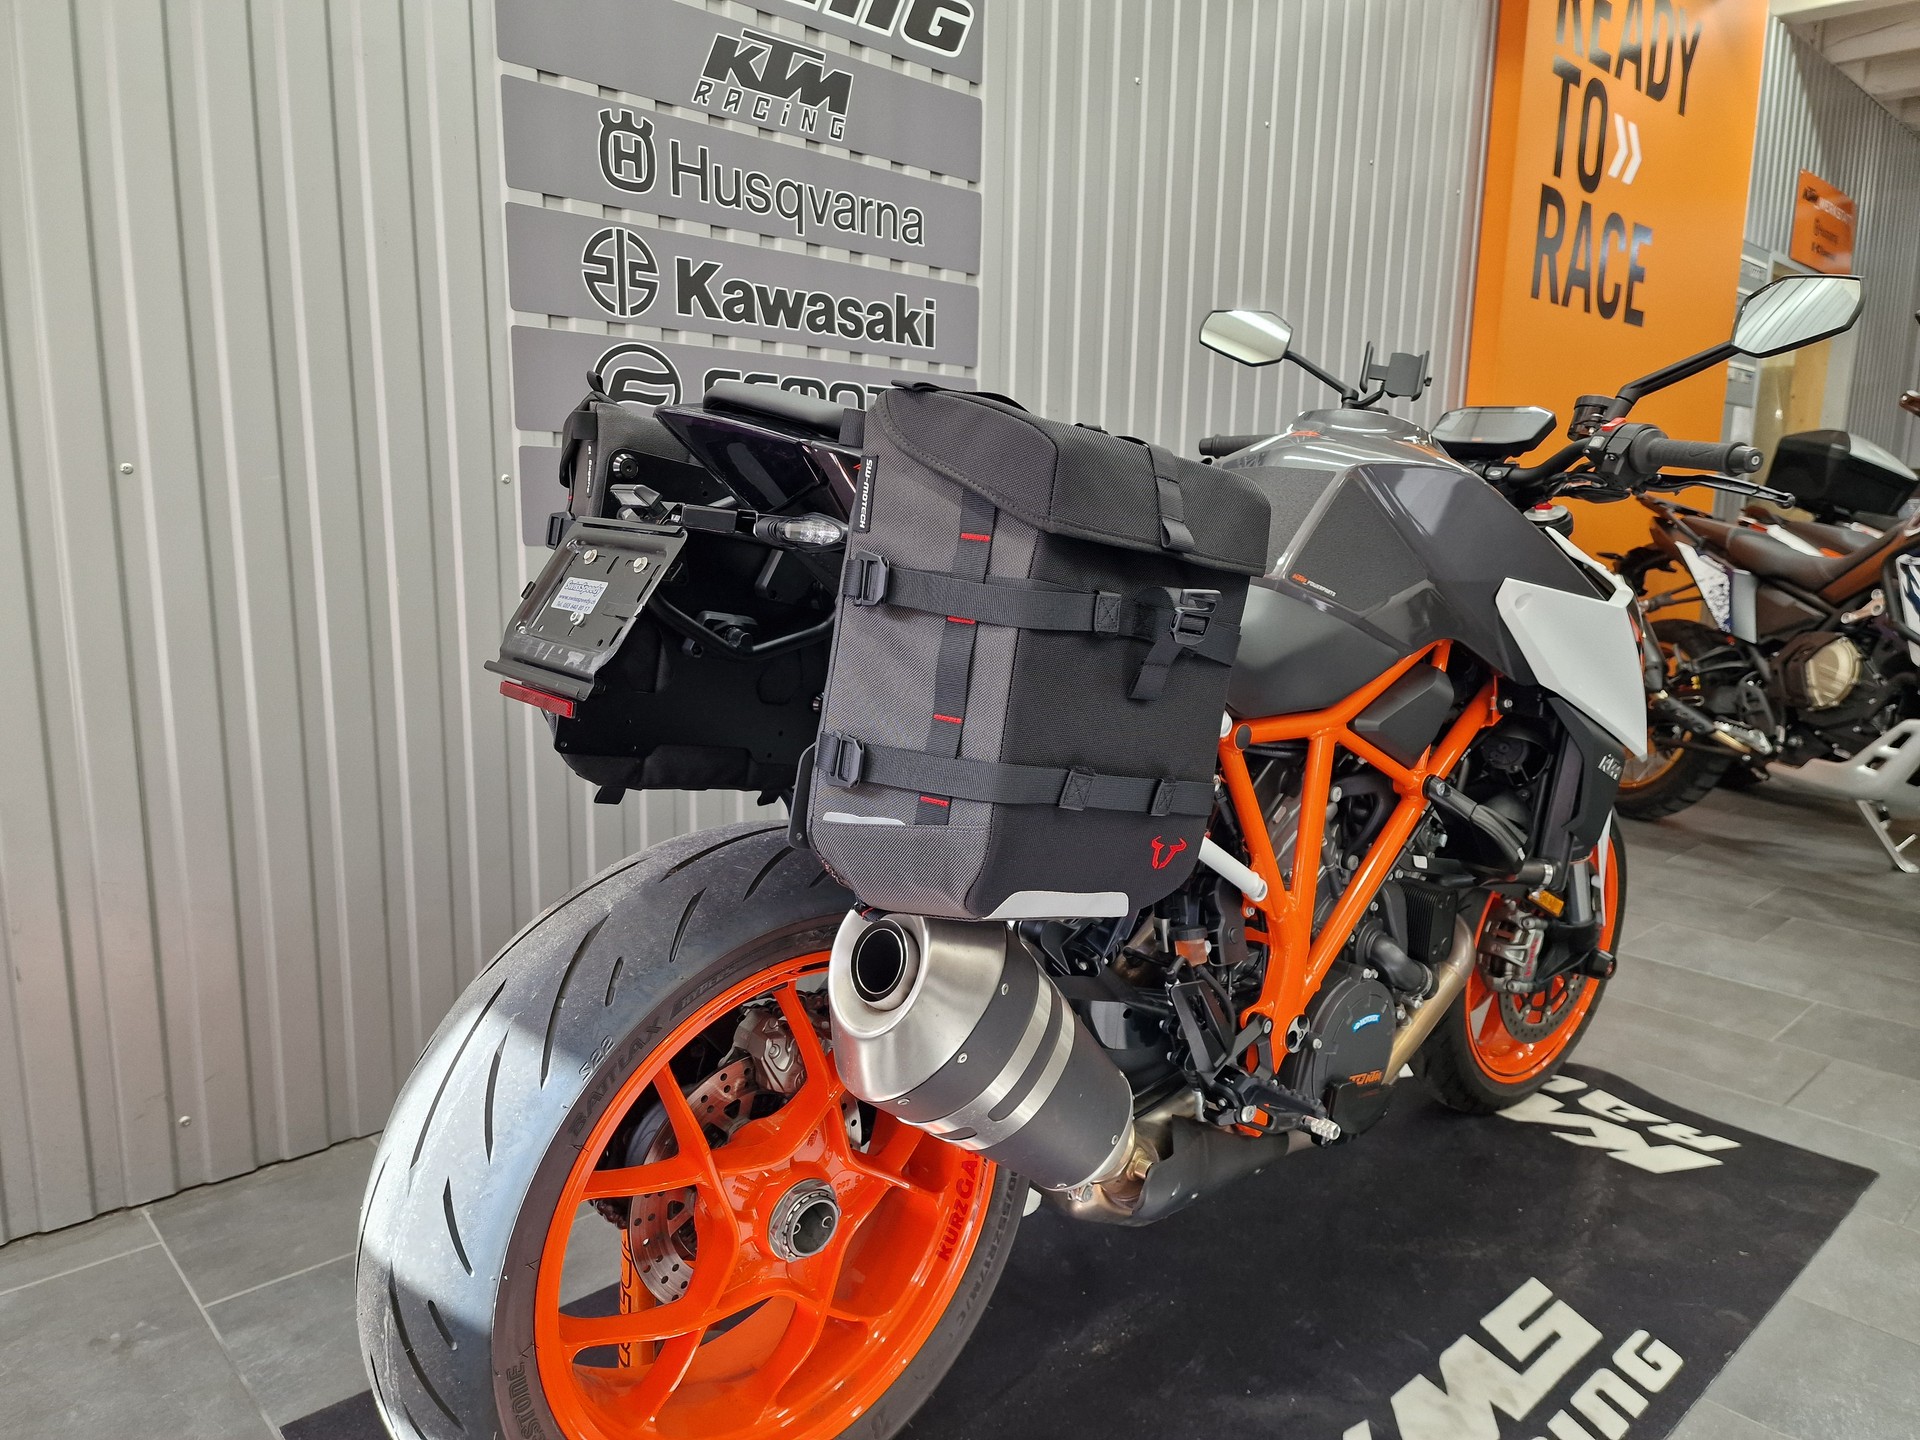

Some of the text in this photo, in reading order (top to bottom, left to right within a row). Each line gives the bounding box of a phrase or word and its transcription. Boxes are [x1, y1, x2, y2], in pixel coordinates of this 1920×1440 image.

[699, 27, 854, 116] KTM
[1552, 55, 1608, 194] TO
[669, 139, 926, 248] Husqvarna
[675, 255, 937, 350] Kawasaki
[1531, 182, 1653, 328] RACE
[859, 458, 873, 529] SW-MOTECH
[578, 1034, 615, 1082] S22
